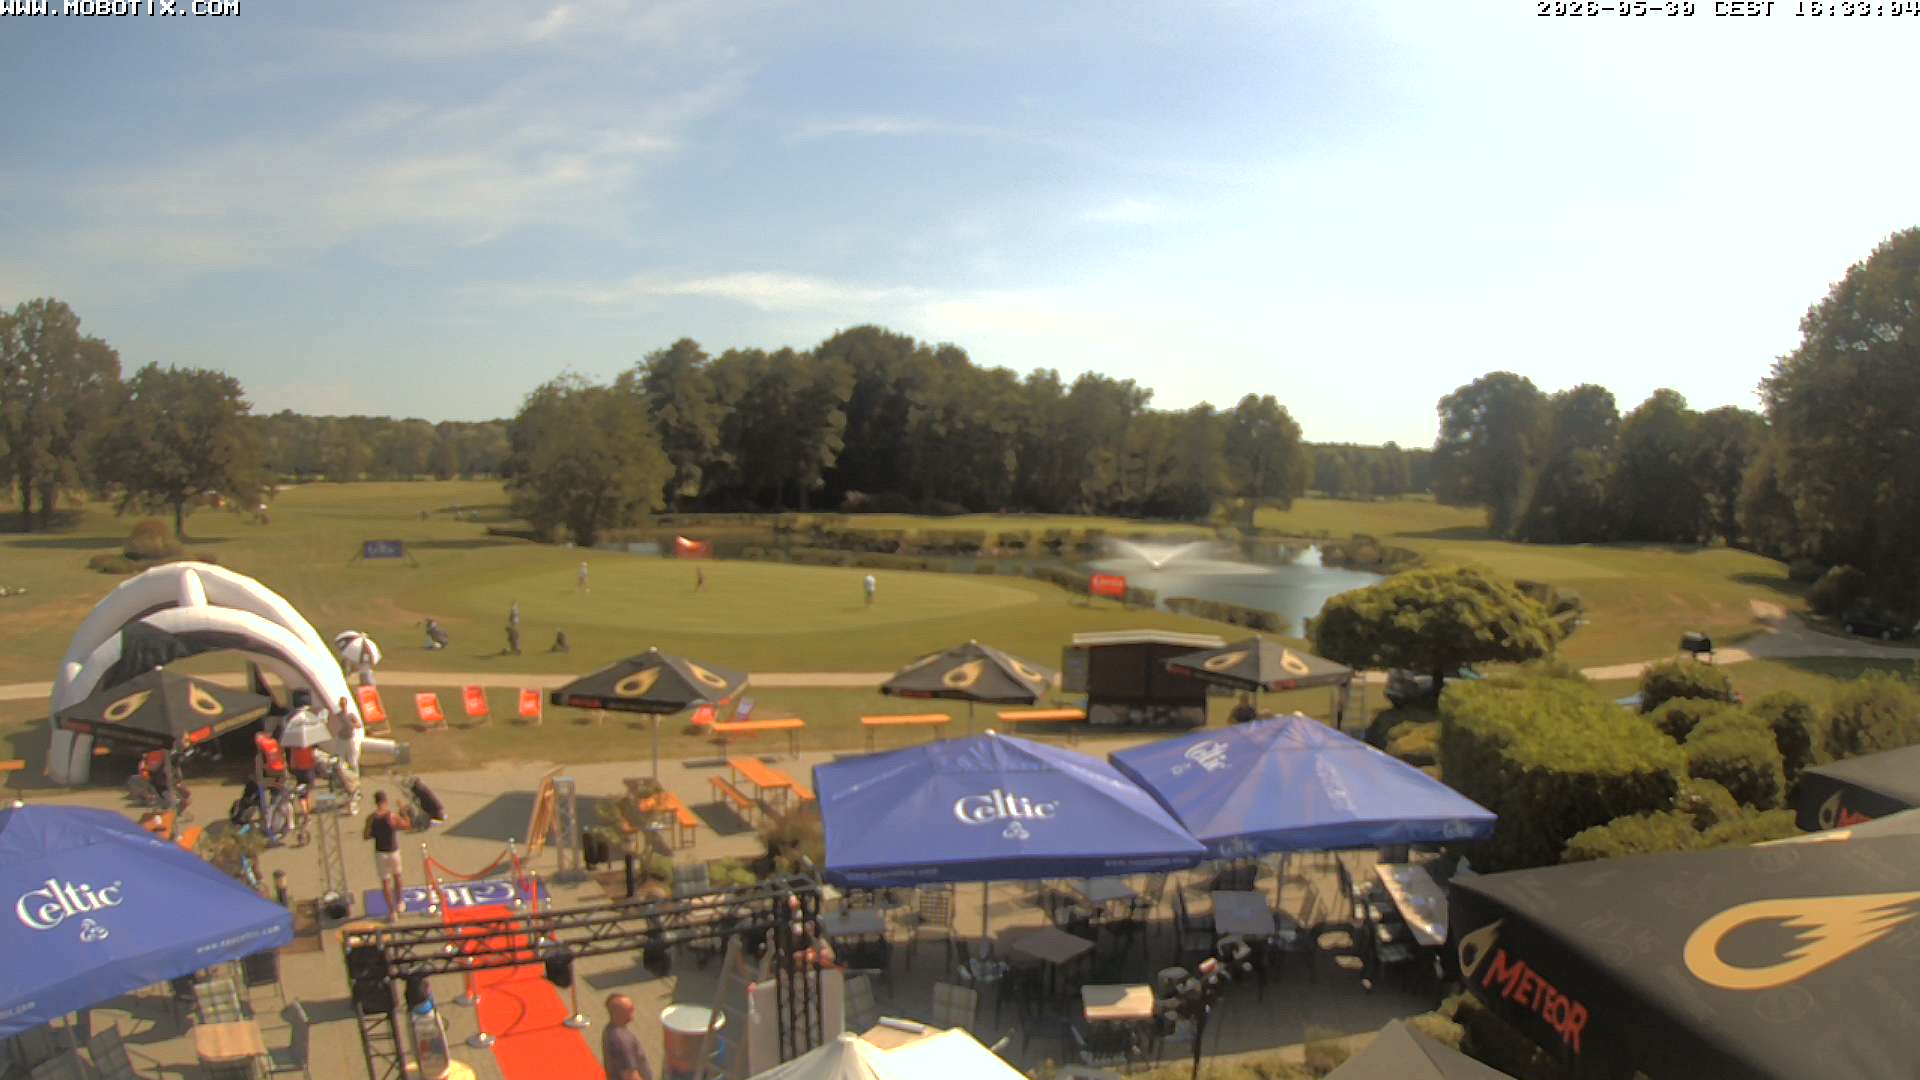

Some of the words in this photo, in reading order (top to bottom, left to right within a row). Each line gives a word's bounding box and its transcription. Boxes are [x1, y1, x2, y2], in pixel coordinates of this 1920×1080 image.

[953, 788, 1058, 824] Celtic
[16, 878, 123, 930] Celtic
[1482, 948, 1589, 1056] METEOR
